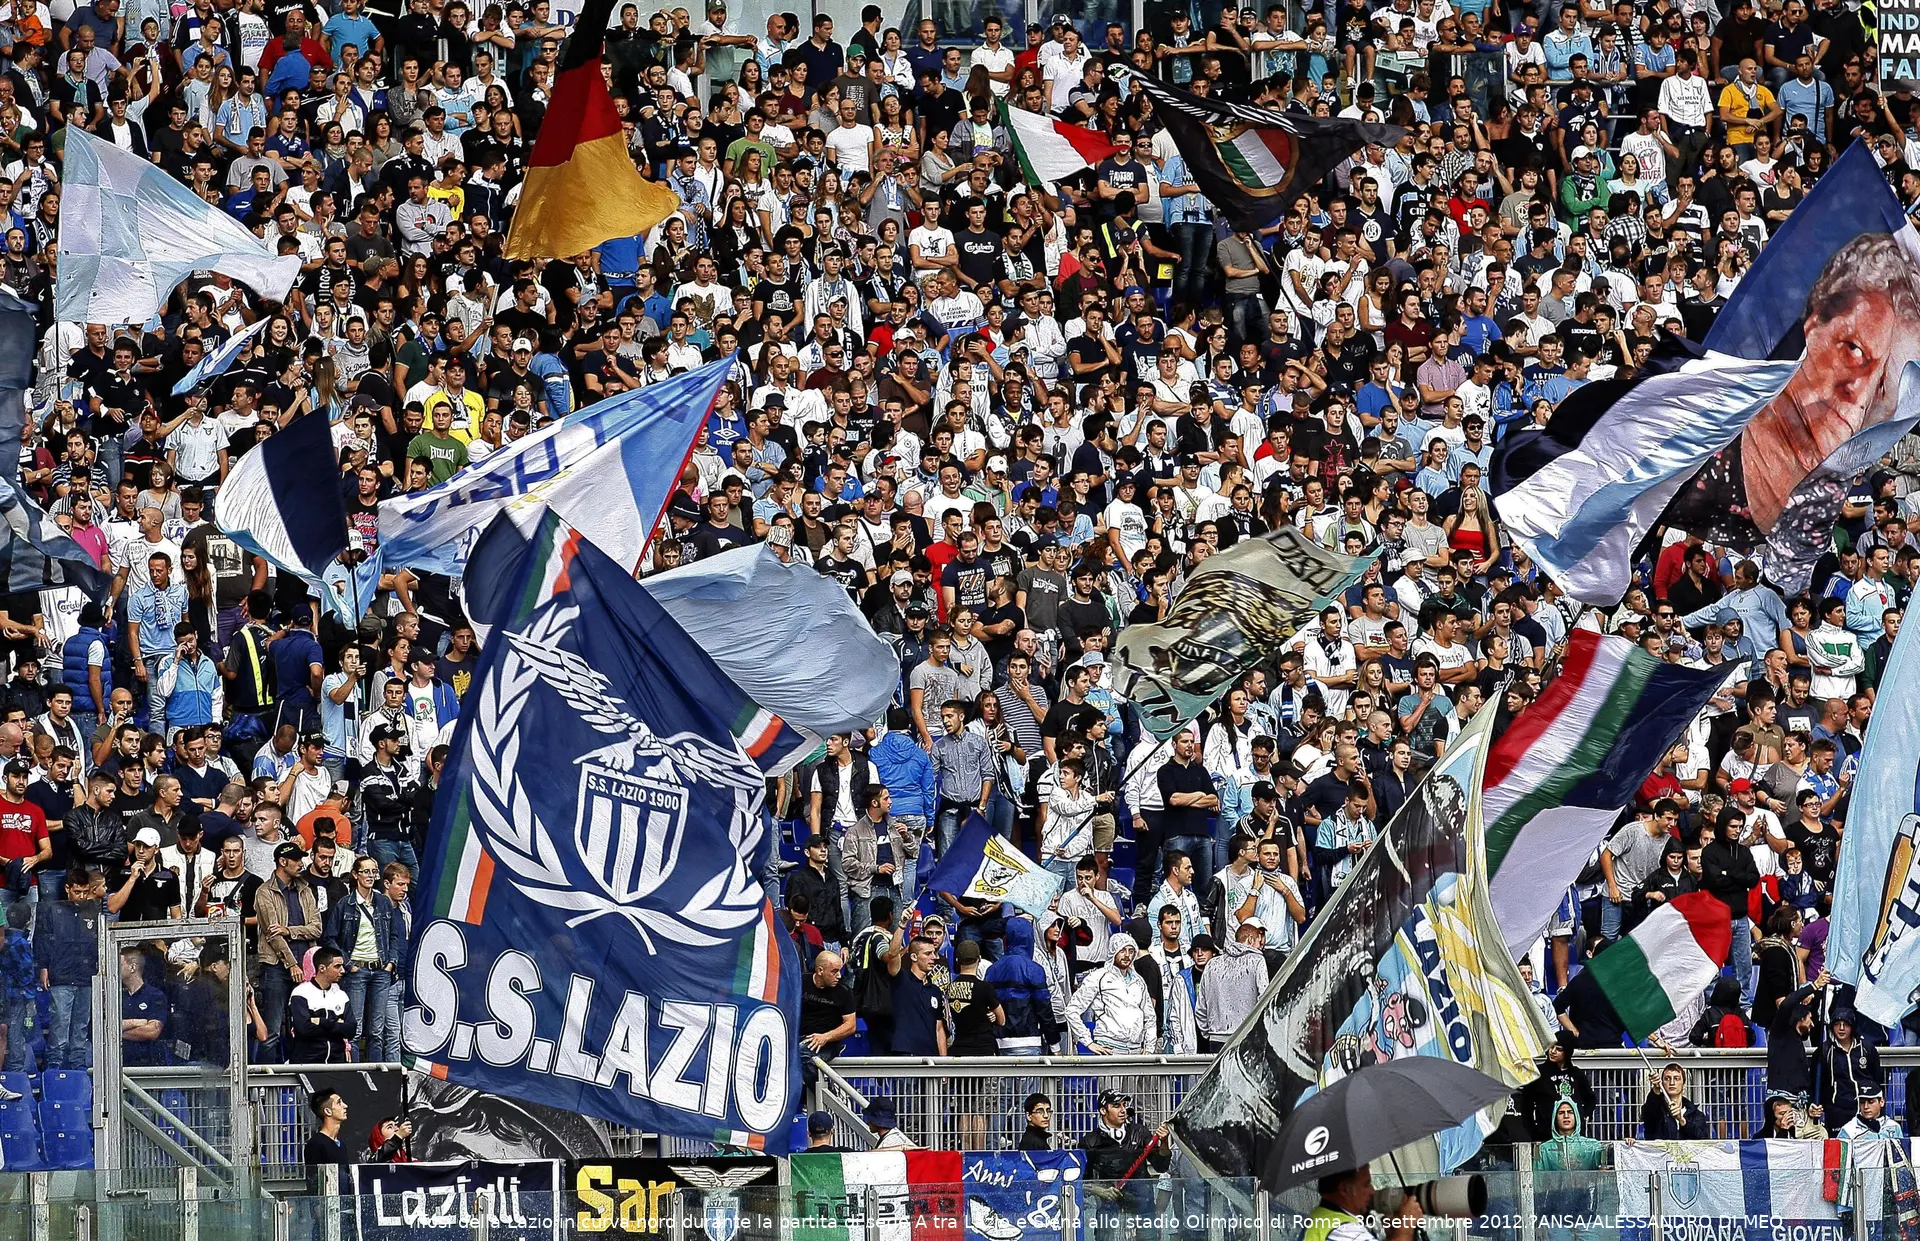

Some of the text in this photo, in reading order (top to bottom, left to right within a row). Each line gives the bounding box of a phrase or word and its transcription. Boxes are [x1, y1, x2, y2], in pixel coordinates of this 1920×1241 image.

[1880, 13, 1920, 30] IND
[1881, 58, 1920, 80] FA
[1408, 207, 1428, 216] CIR
[964, 241, 995, 254] Carlsberg
[430, 444, 455, 463] EVERLAST
[57, 599, 82, 615] Carlsb
[587, 775, 679, 811] S.S. LAZIO 1900
[1291, 1150, 1340, 1174] INESIS
